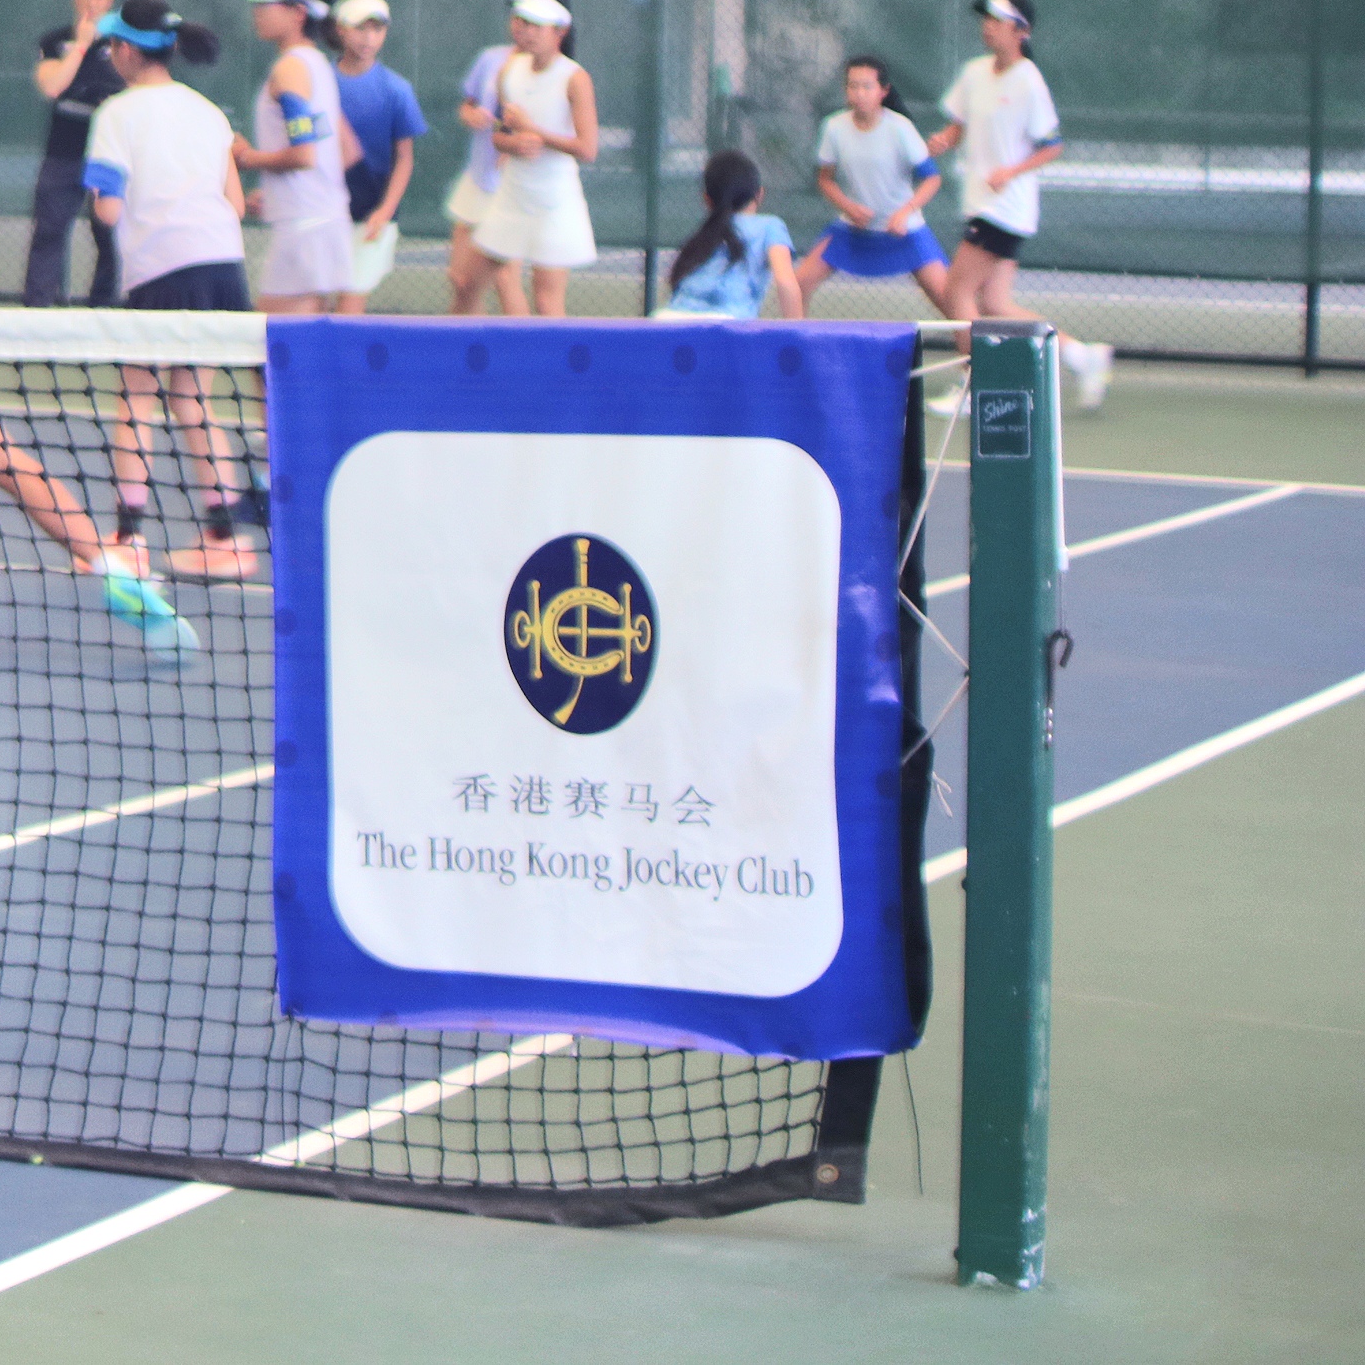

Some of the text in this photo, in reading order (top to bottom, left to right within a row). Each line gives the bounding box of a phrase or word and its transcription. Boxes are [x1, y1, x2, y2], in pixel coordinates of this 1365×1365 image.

[453, 772, 717, 828] 香港赛马会
[357, 830, 816, 902] The Hong Kong Jockey Club
